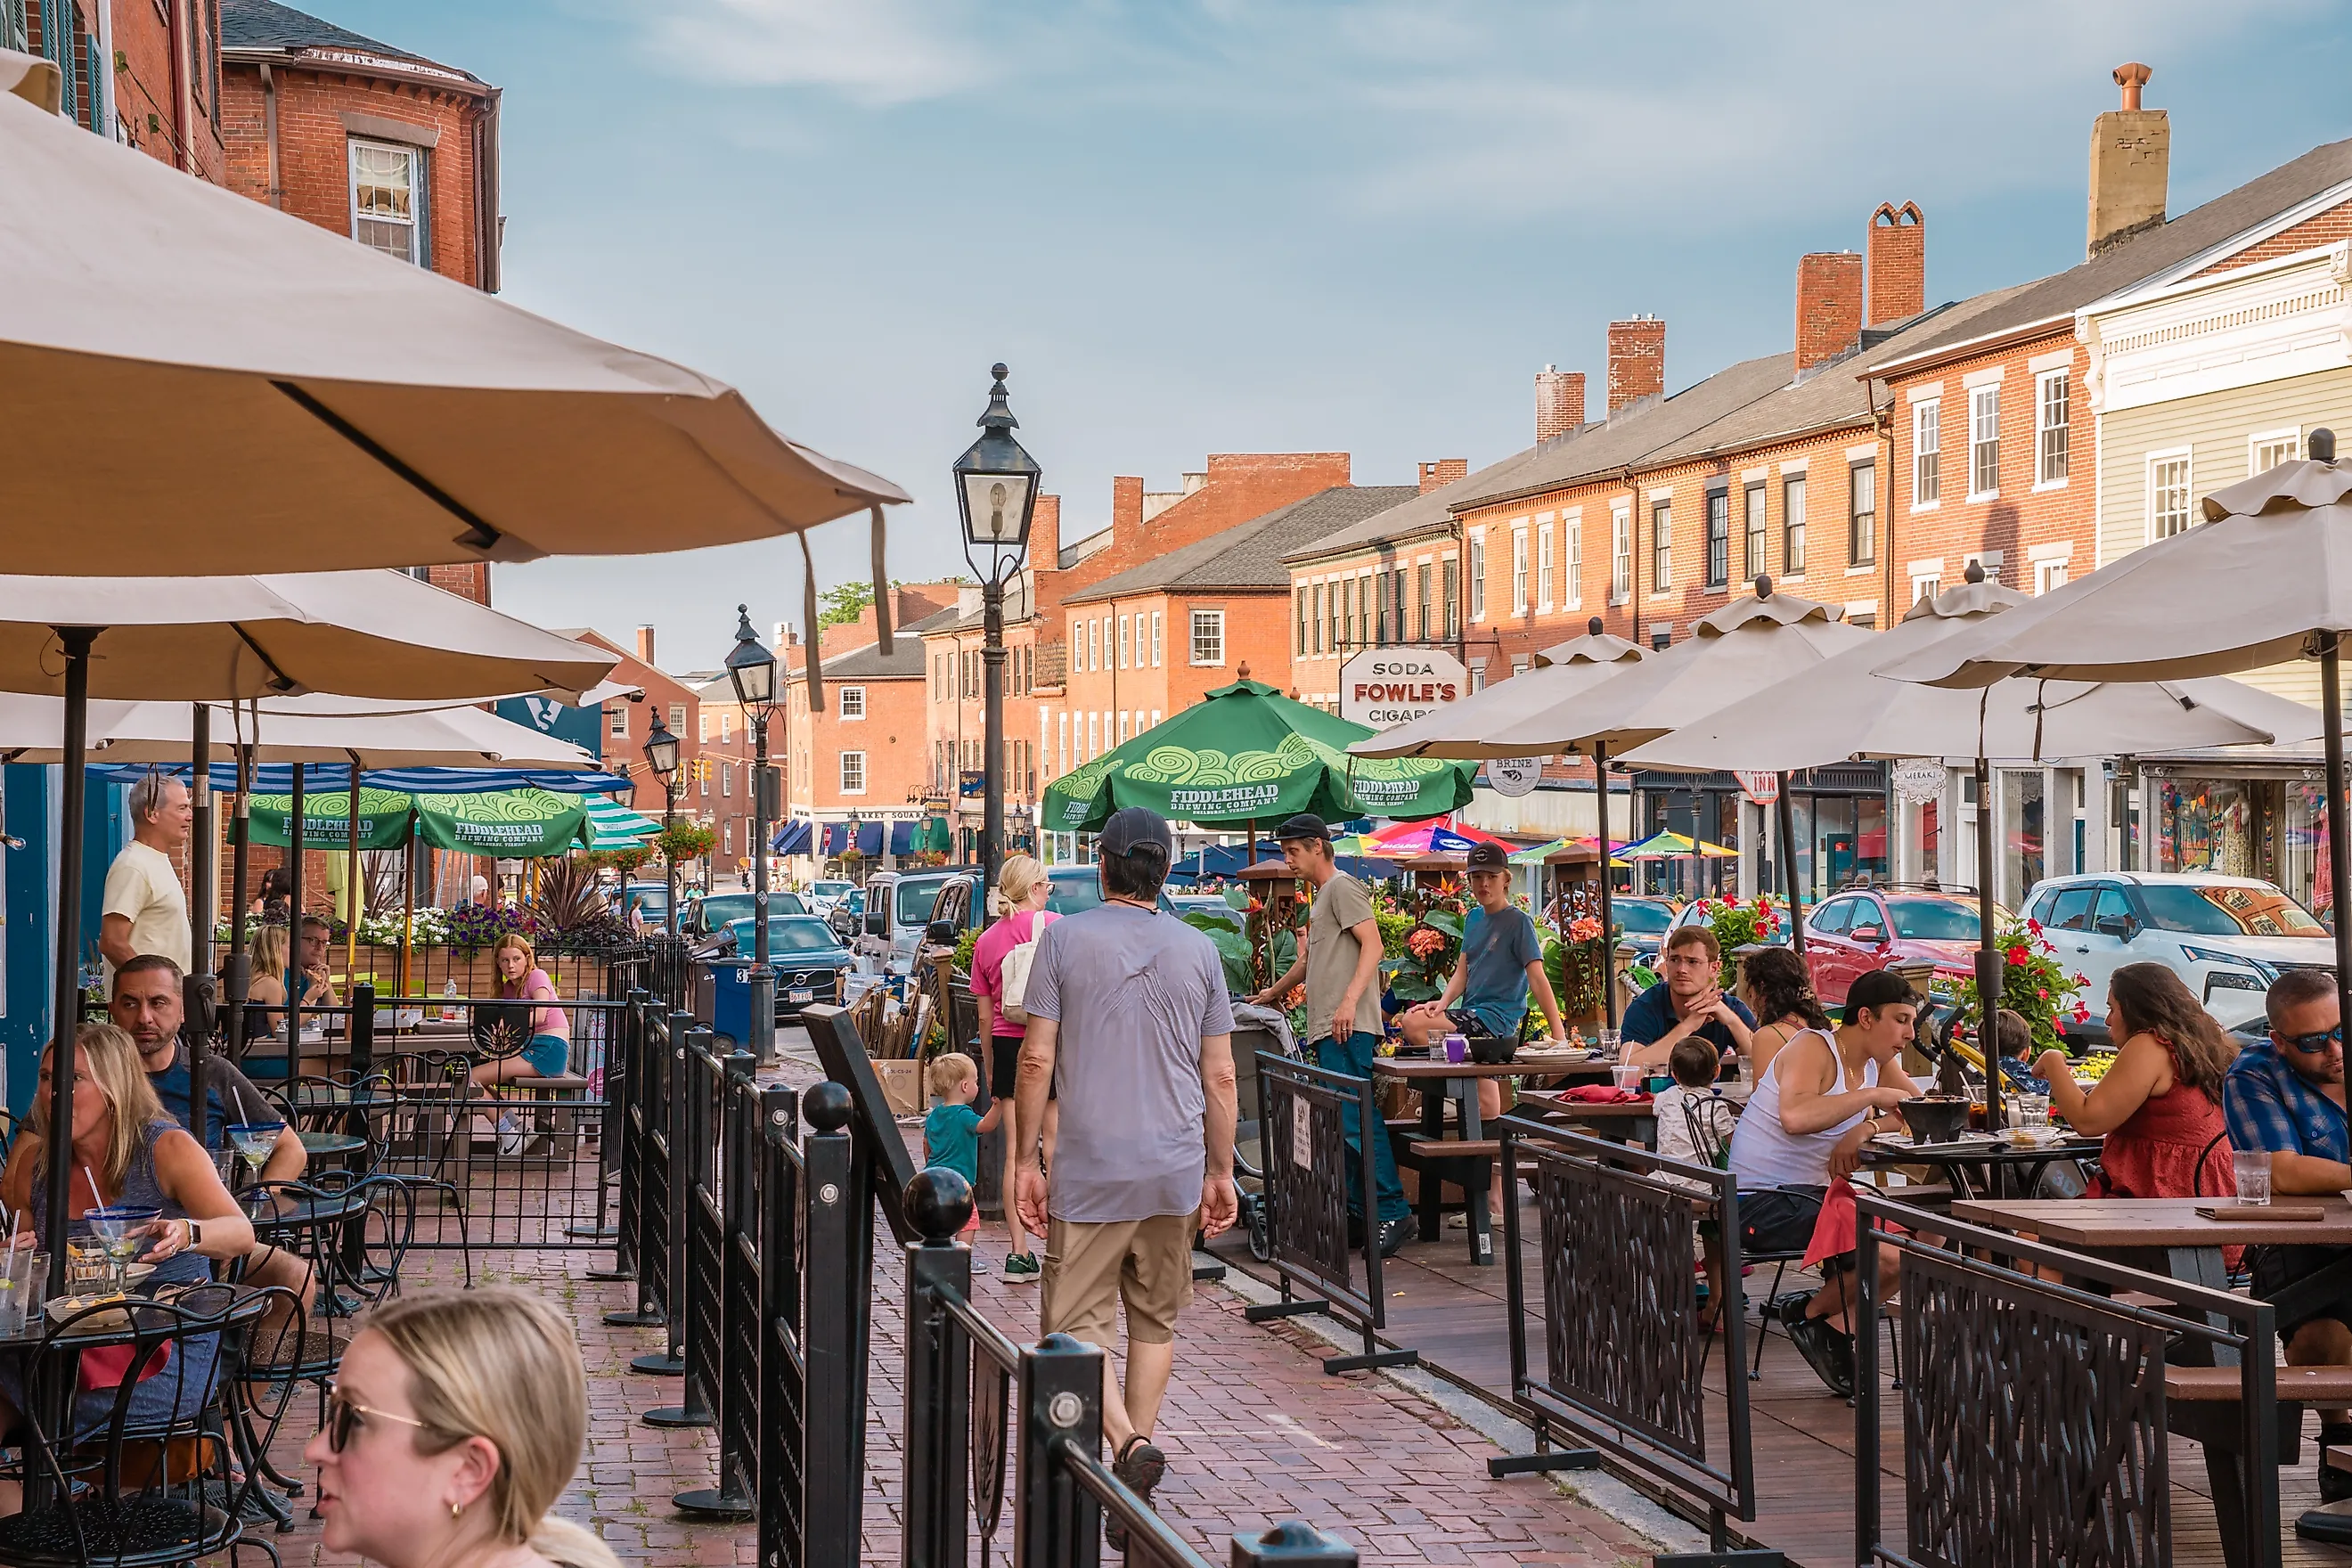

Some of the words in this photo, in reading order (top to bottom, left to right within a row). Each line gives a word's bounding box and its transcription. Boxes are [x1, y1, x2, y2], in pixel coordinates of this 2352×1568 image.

[1372, 663, 1434, 675] SODA
[1354, 682, 1457, 703] FOWLE'S
[1368, 709, 1436, 723] CIGAR
[1496, 758, 1532, 768] BRINE
[1903, 772, 1936, 780] MERAKI
[1353, 780, 1420, 795] FIDDLEHEAD
[1753, 776, 1776, 792] INN
[1171, 784, 1279, 804] FIDDLEHEAD
[1386, 793, 1418, 801] COMPANY
[1171, 803, 1221, 811] BREWING
[1227, 797, 1278, 809] COMPANY
[282, 816, 374, 831] FDLEHED
[455, 822, 543, 836] FIDDLEHEAD
[2053, 1169, 2080, 1196] 3D
